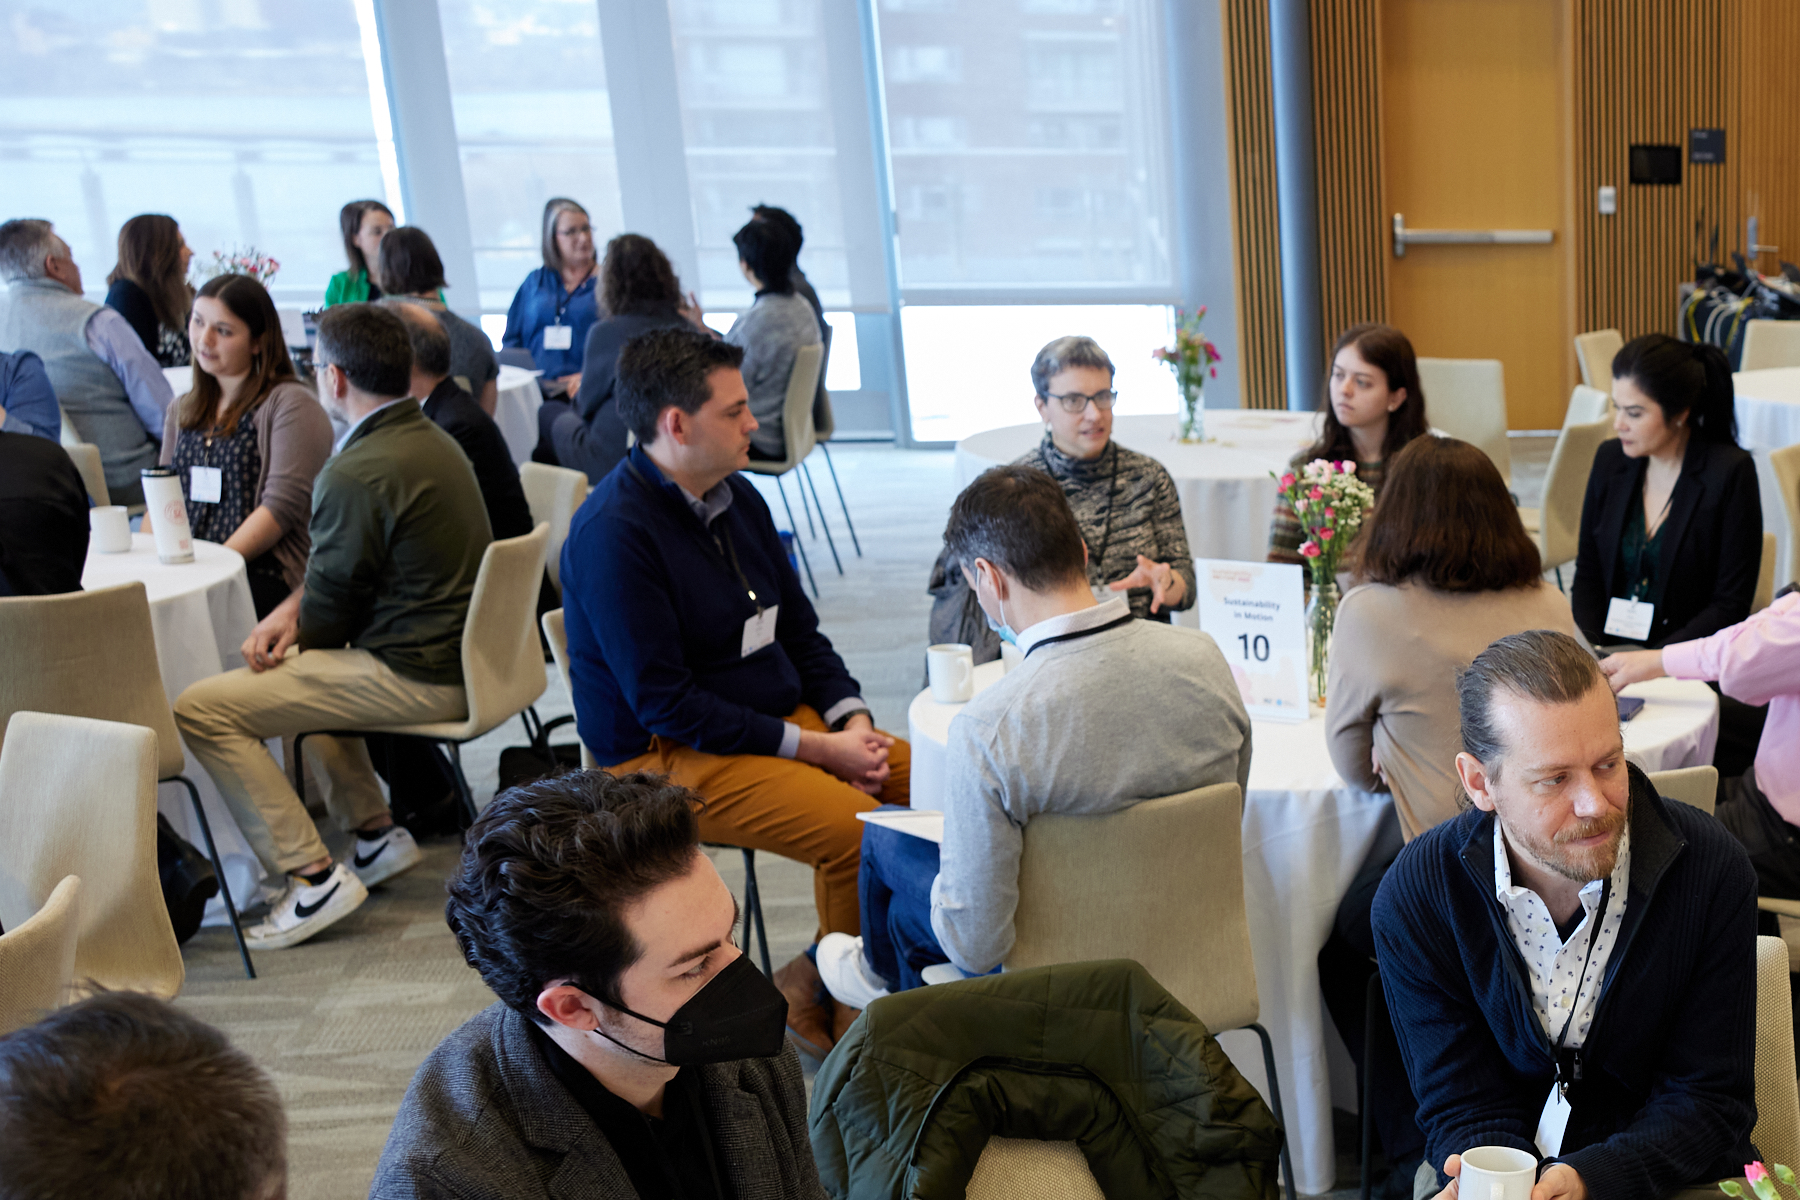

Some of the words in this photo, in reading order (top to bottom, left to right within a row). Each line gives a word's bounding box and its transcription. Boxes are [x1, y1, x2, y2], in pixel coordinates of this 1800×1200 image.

[1224, 596, 1281, 611] Sustainability
[1234, 611, 1243, 619] in
[1244, 612, 1274, 622] Motion
[1238, 633, 1270, 662] 10
